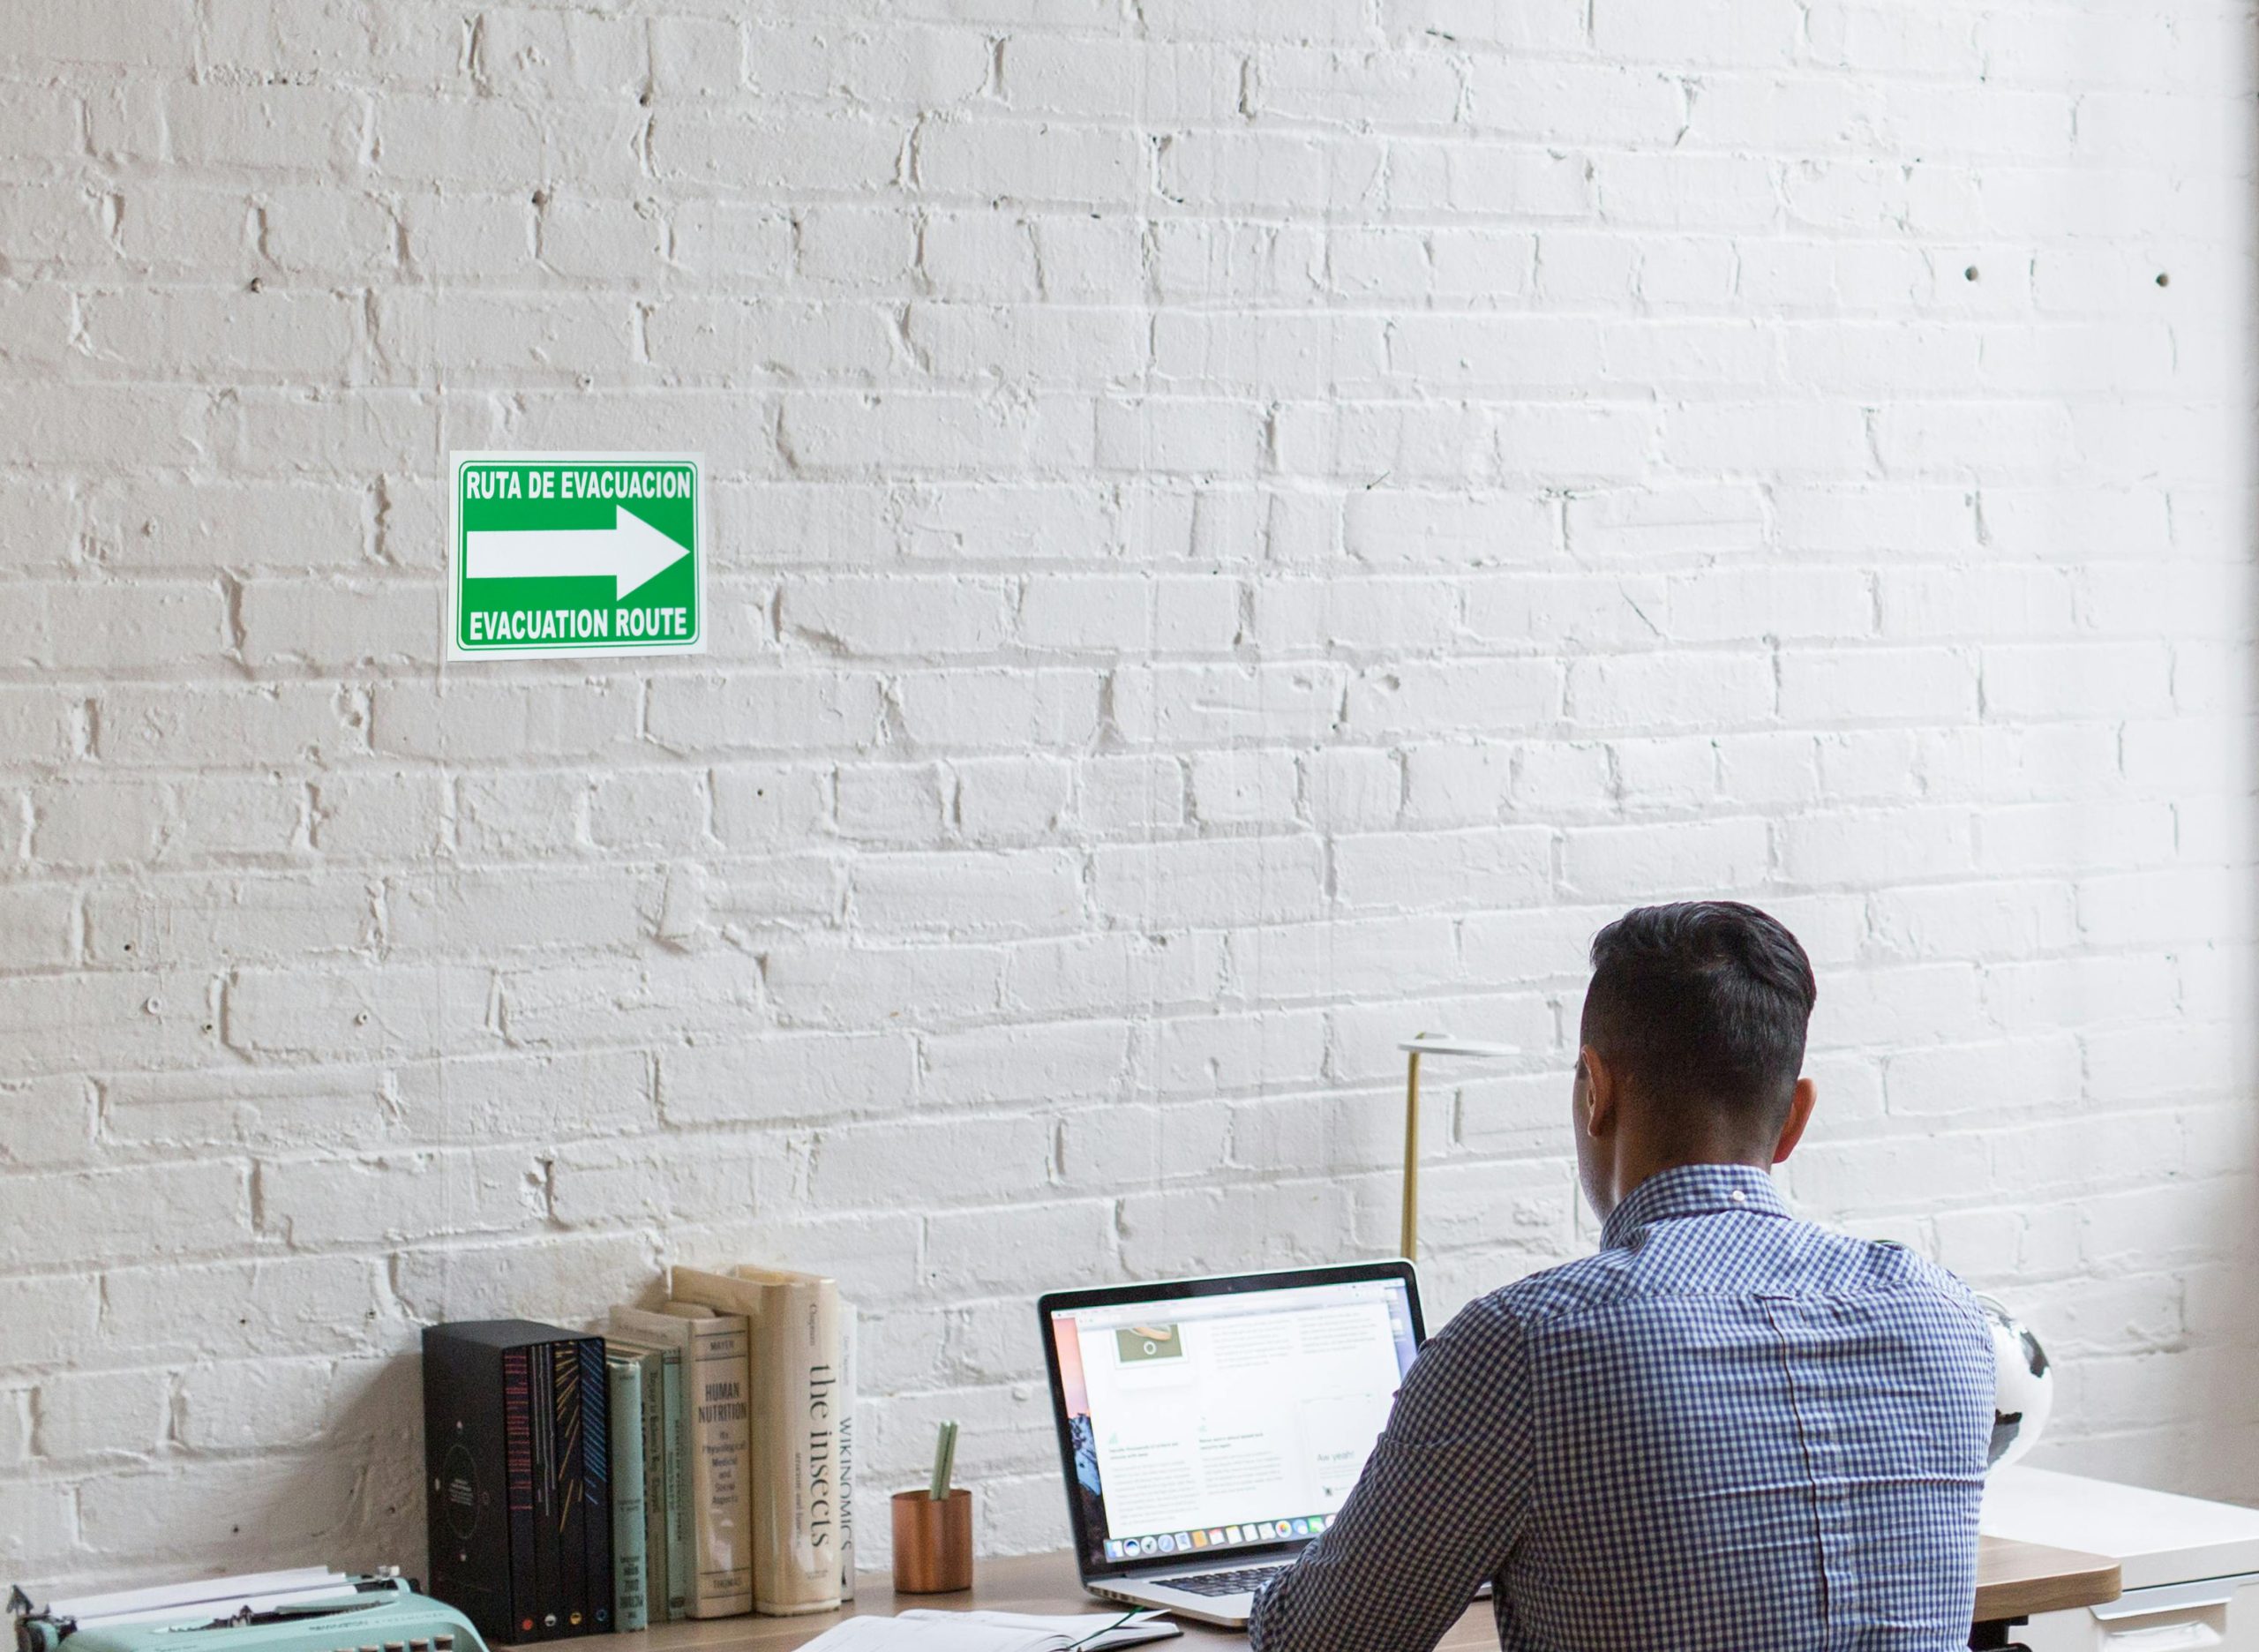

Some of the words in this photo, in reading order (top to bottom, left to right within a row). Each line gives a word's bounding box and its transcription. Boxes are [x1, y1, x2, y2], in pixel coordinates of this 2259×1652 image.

[467, 470, 522, 499] RUTA
[529, 471, 554, 499] DE
[561, 471, 691, 499] EVACUACION
[470, 609, 608, 641] EVACUATION
[616, 607, 687, 637] ROUTE
[710, 1340, 734, 1350] MAYER
[705, 1383, 739, 1401] HUMAN
[809, 1363, 836, 1419] the
[698, 1402, 747, 1423] NUTRITION
[809, 1430, 833, 1548] insects
[840, 1416, 853, 1551] WIKINOMICS
